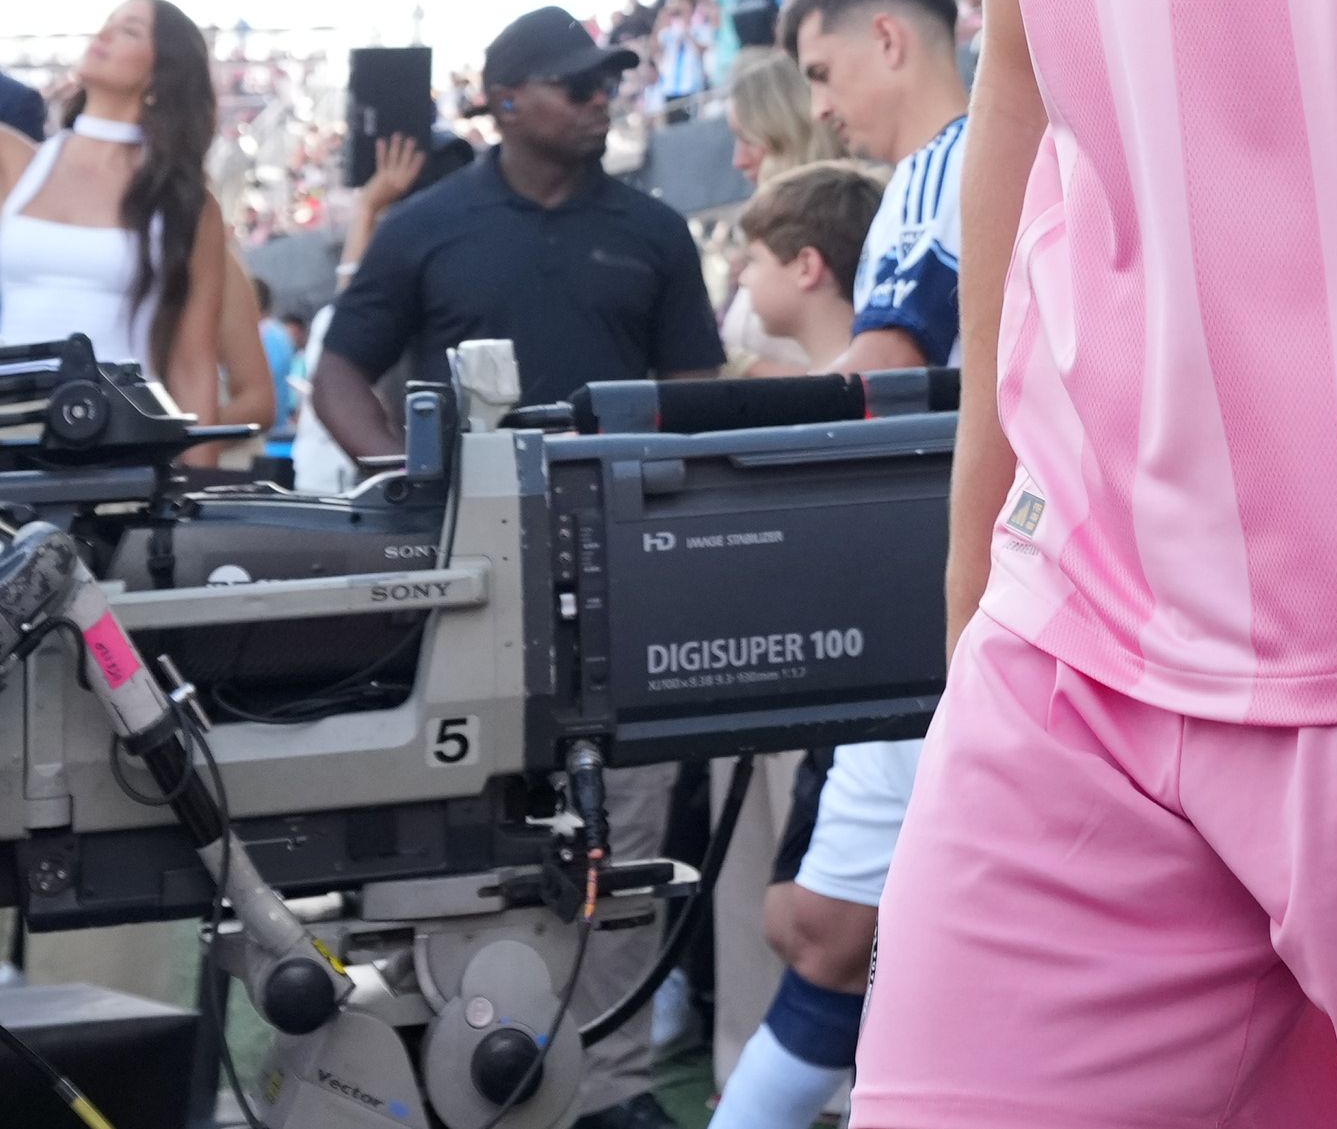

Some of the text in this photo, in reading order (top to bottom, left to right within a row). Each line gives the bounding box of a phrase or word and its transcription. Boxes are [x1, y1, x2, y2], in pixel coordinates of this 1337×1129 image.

[643, 532, 677, 552] HD
[370, 583, 449, 602] SONY
[647, 628, 864, 674] DIGISUPER 100
[433, 718, 469, 763] 5
[319, 1069, 385, 1107] Vector
